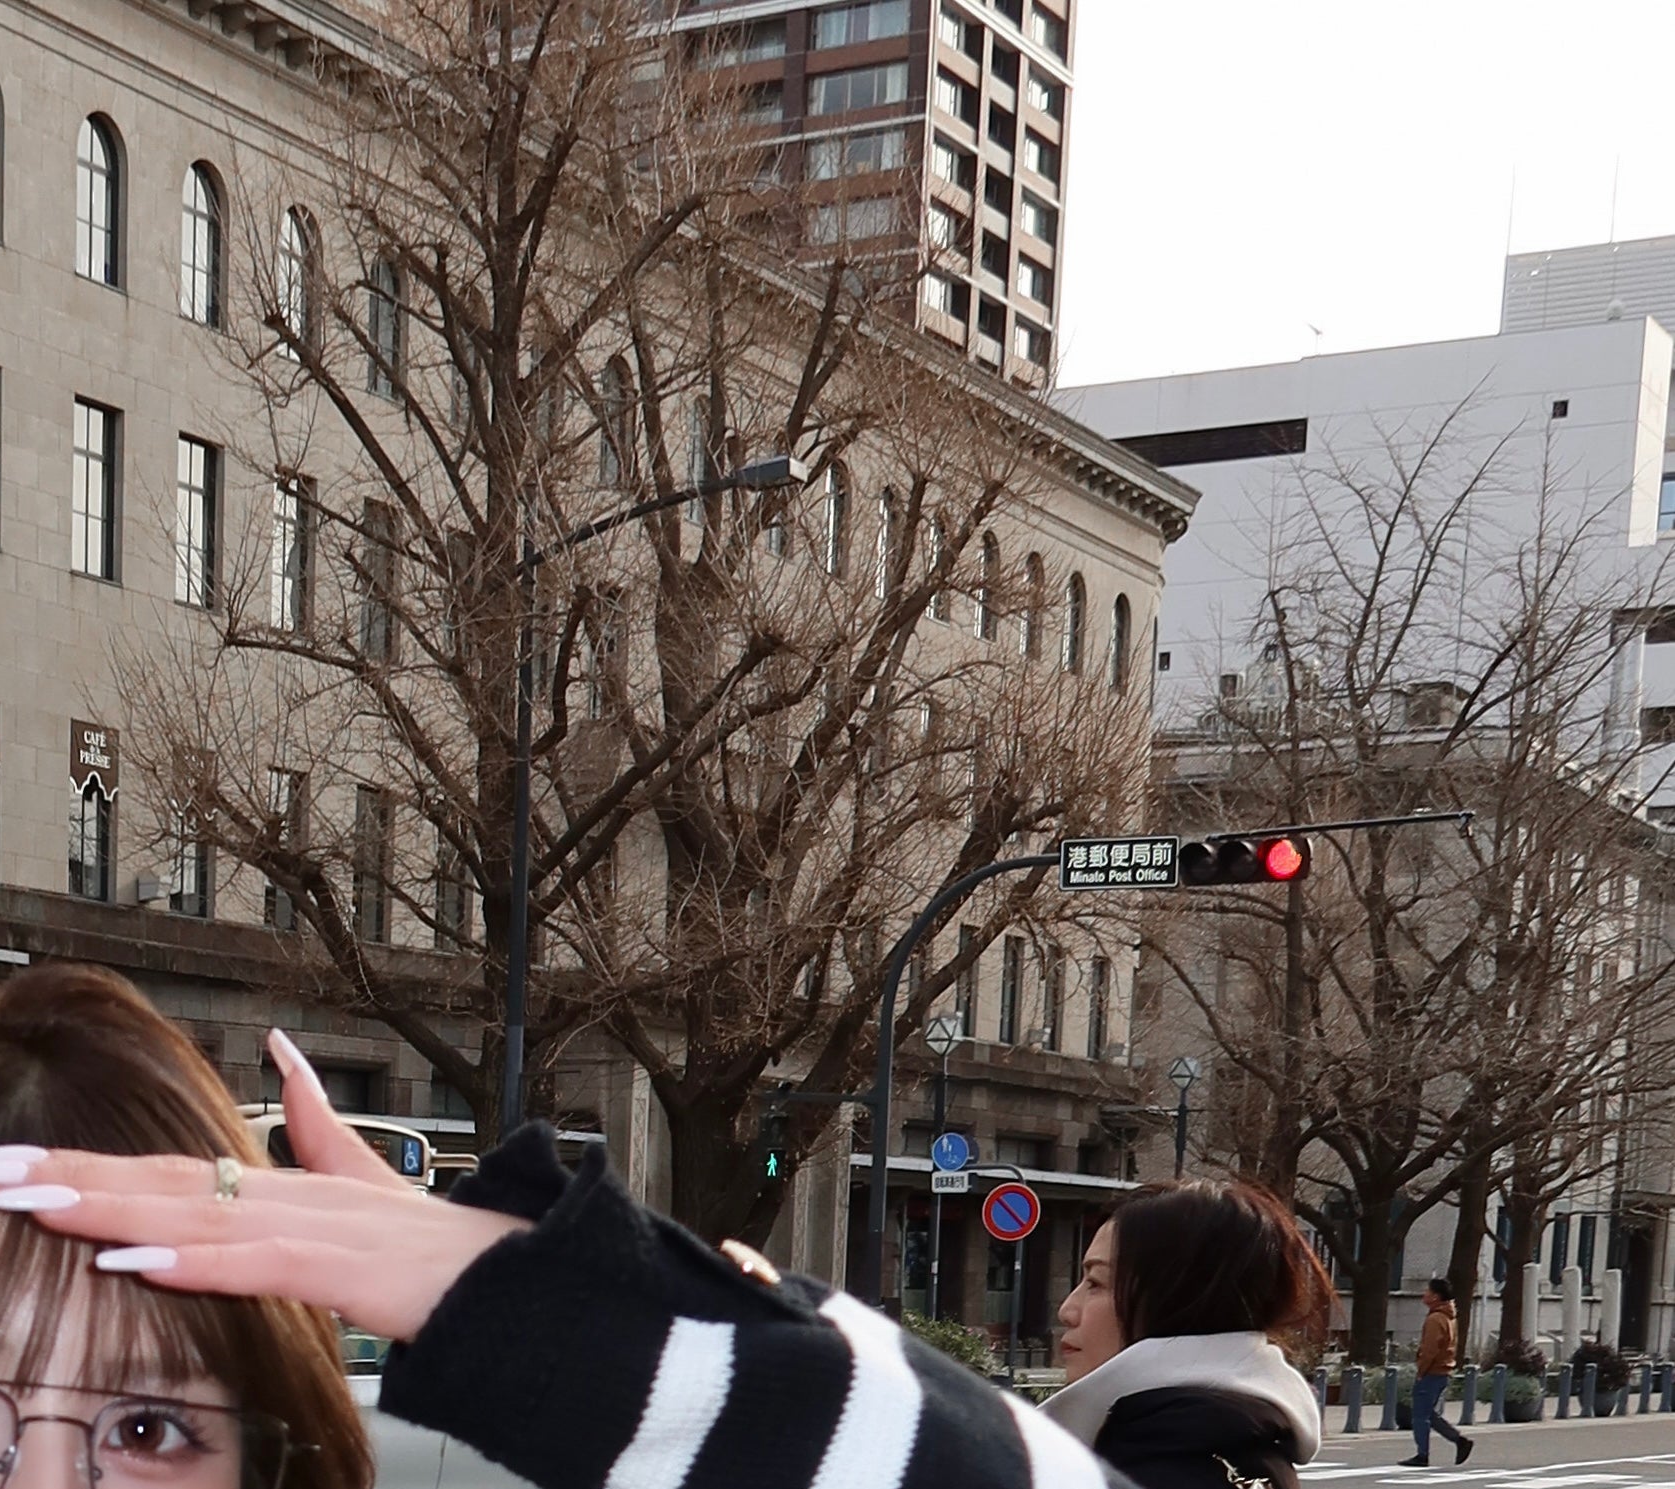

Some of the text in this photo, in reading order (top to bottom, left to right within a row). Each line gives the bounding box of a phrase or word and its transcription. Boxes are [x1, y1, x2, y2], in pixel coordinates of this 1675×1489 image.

[1067, 842, 1173, 868] 港郵便局前
[1069, 869, 1168, 883] Minato Post Office
